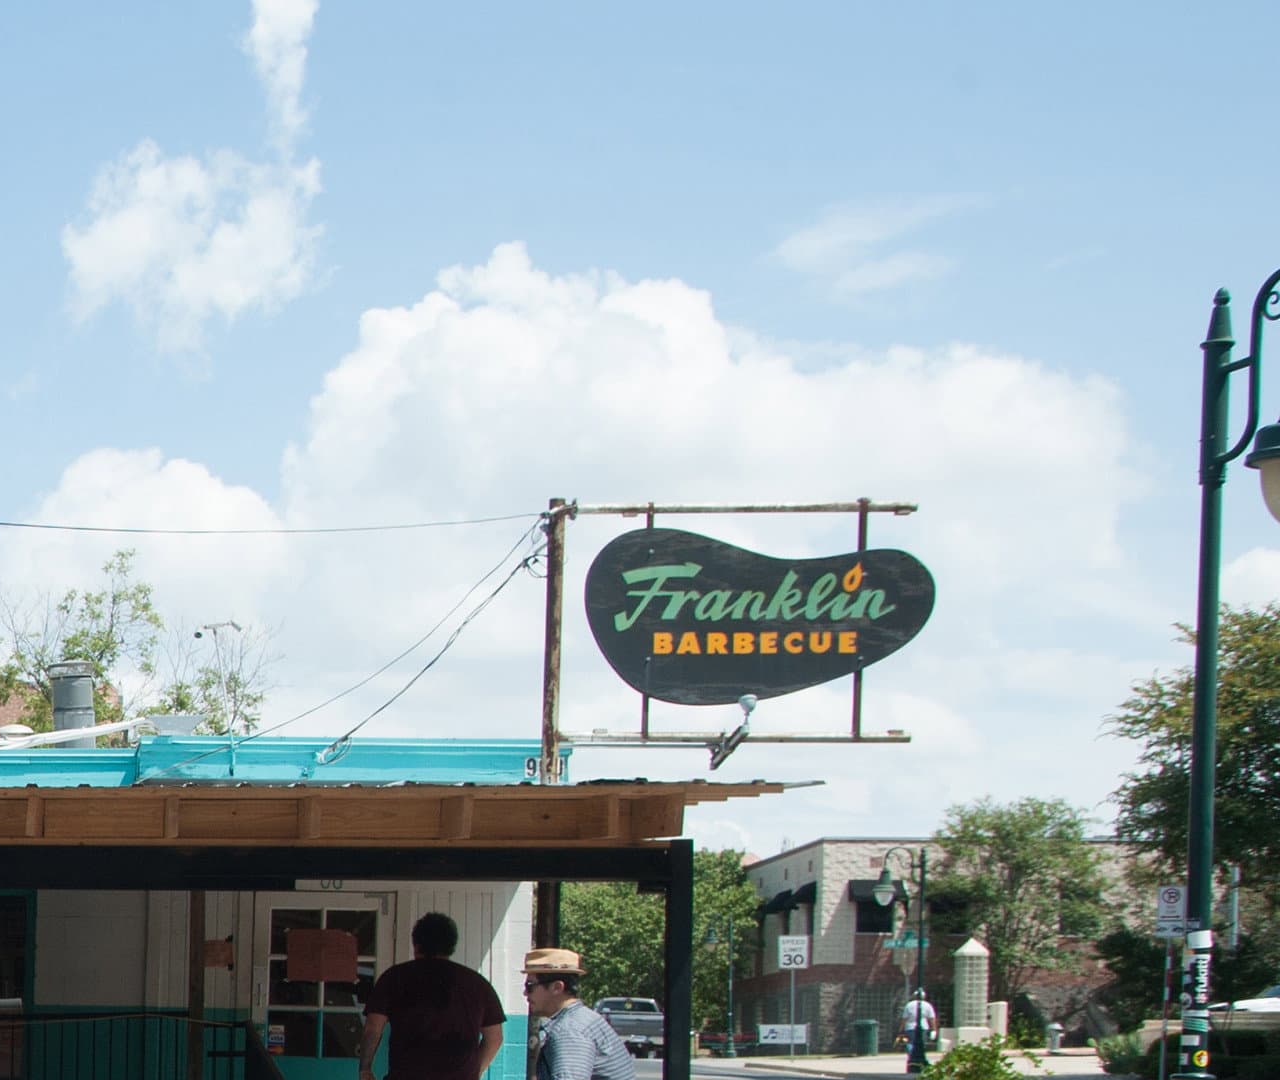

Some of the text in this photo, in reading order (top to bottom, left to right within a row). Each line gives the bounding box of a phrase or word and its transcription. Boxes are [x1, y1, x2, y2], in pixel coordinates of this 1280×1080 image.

[614, 562, 896, 632] Franklin
[653, 632, 858, 655] BARBECUE
[783, 954, 804, 966] 30
